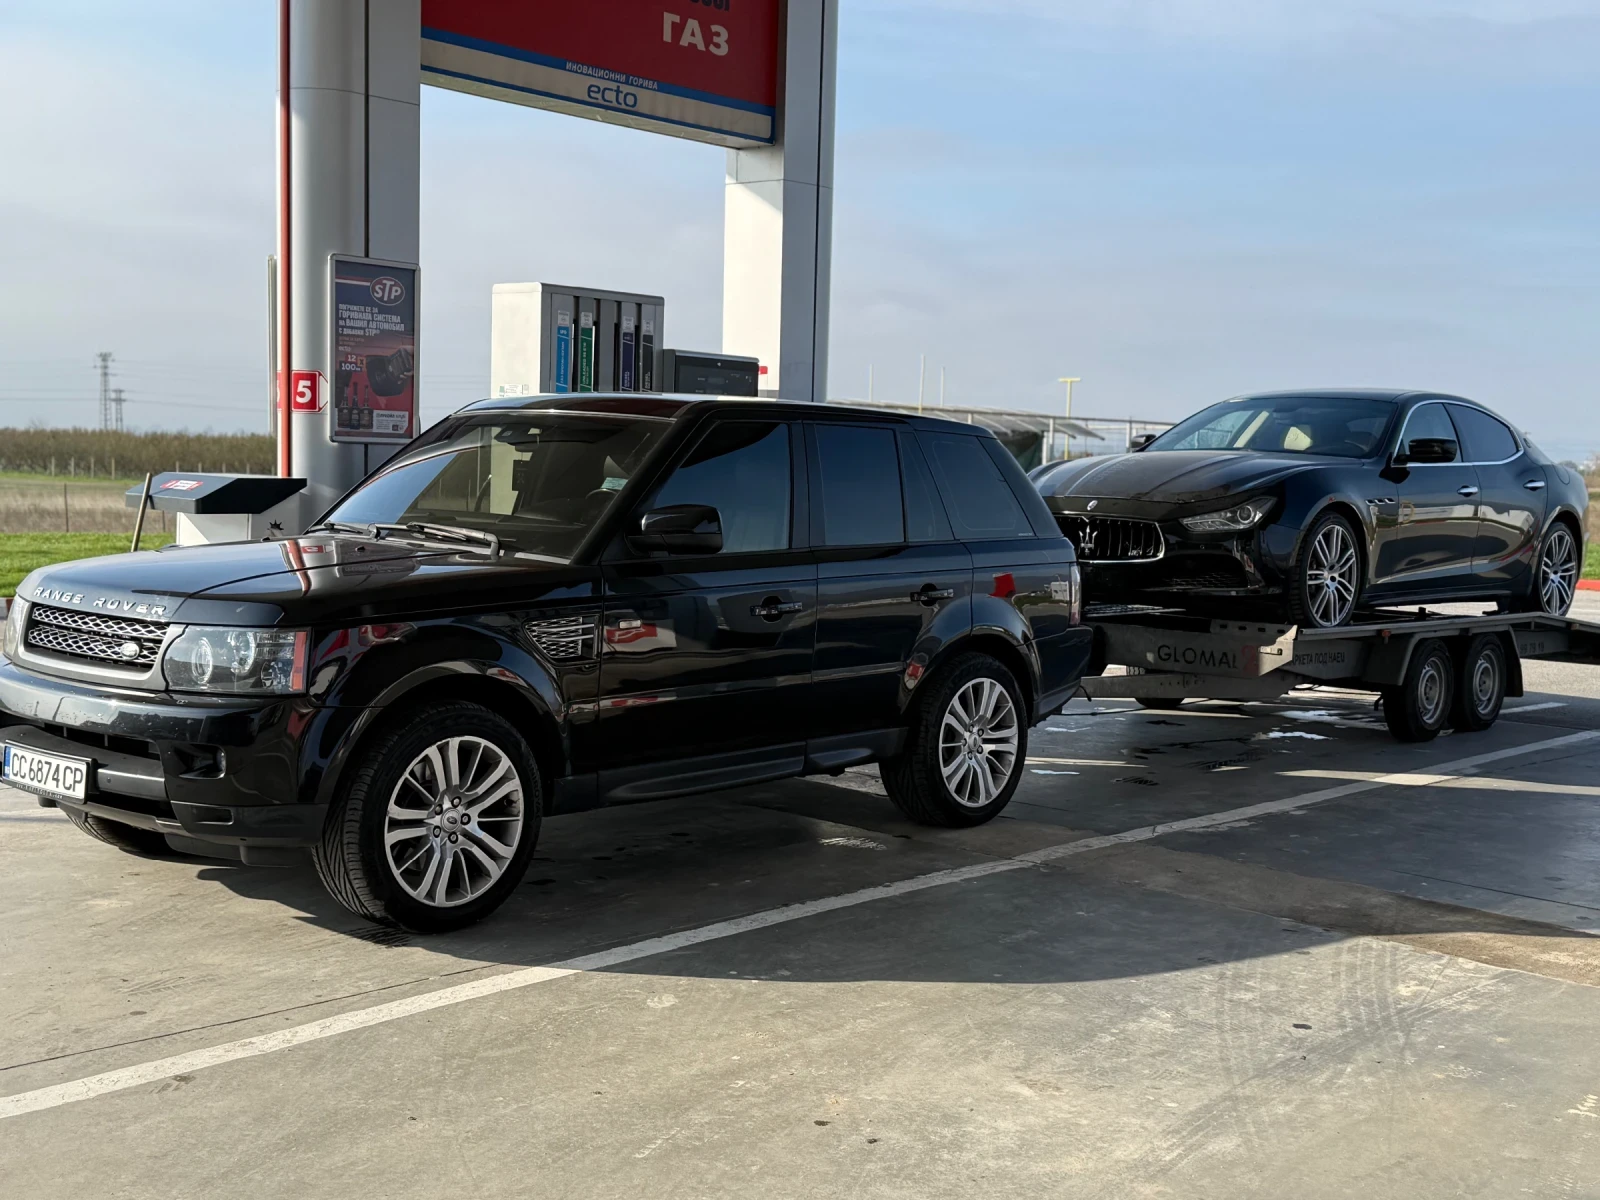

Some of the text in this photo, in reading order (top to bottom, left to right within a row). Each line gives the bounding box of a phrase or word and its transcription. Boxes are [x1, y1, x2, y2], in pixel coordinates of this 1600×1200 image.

[663, 11, 729, 56] ГАЗ
[566, 61, 658, 90] ИНОВАЦИОННИ ГОРИВА
[587, 84, 638, 108] ecto
[373, 280, 402, 301] STP
[338, 318, 405, 332] НА ВАШИЯ АВТОМОБИЛ
[339, 310, 401, 323] ГОРИВНАТА СИСТЕМА
[347, 354, 357, 362] 12
[296, 379, 312, 404] 5
[33, 587, 167, 616] RANGE ROVER
[1157, 645, 1238, 670] GLOMAL
[12, 753, 84, 792] CC6874CP
